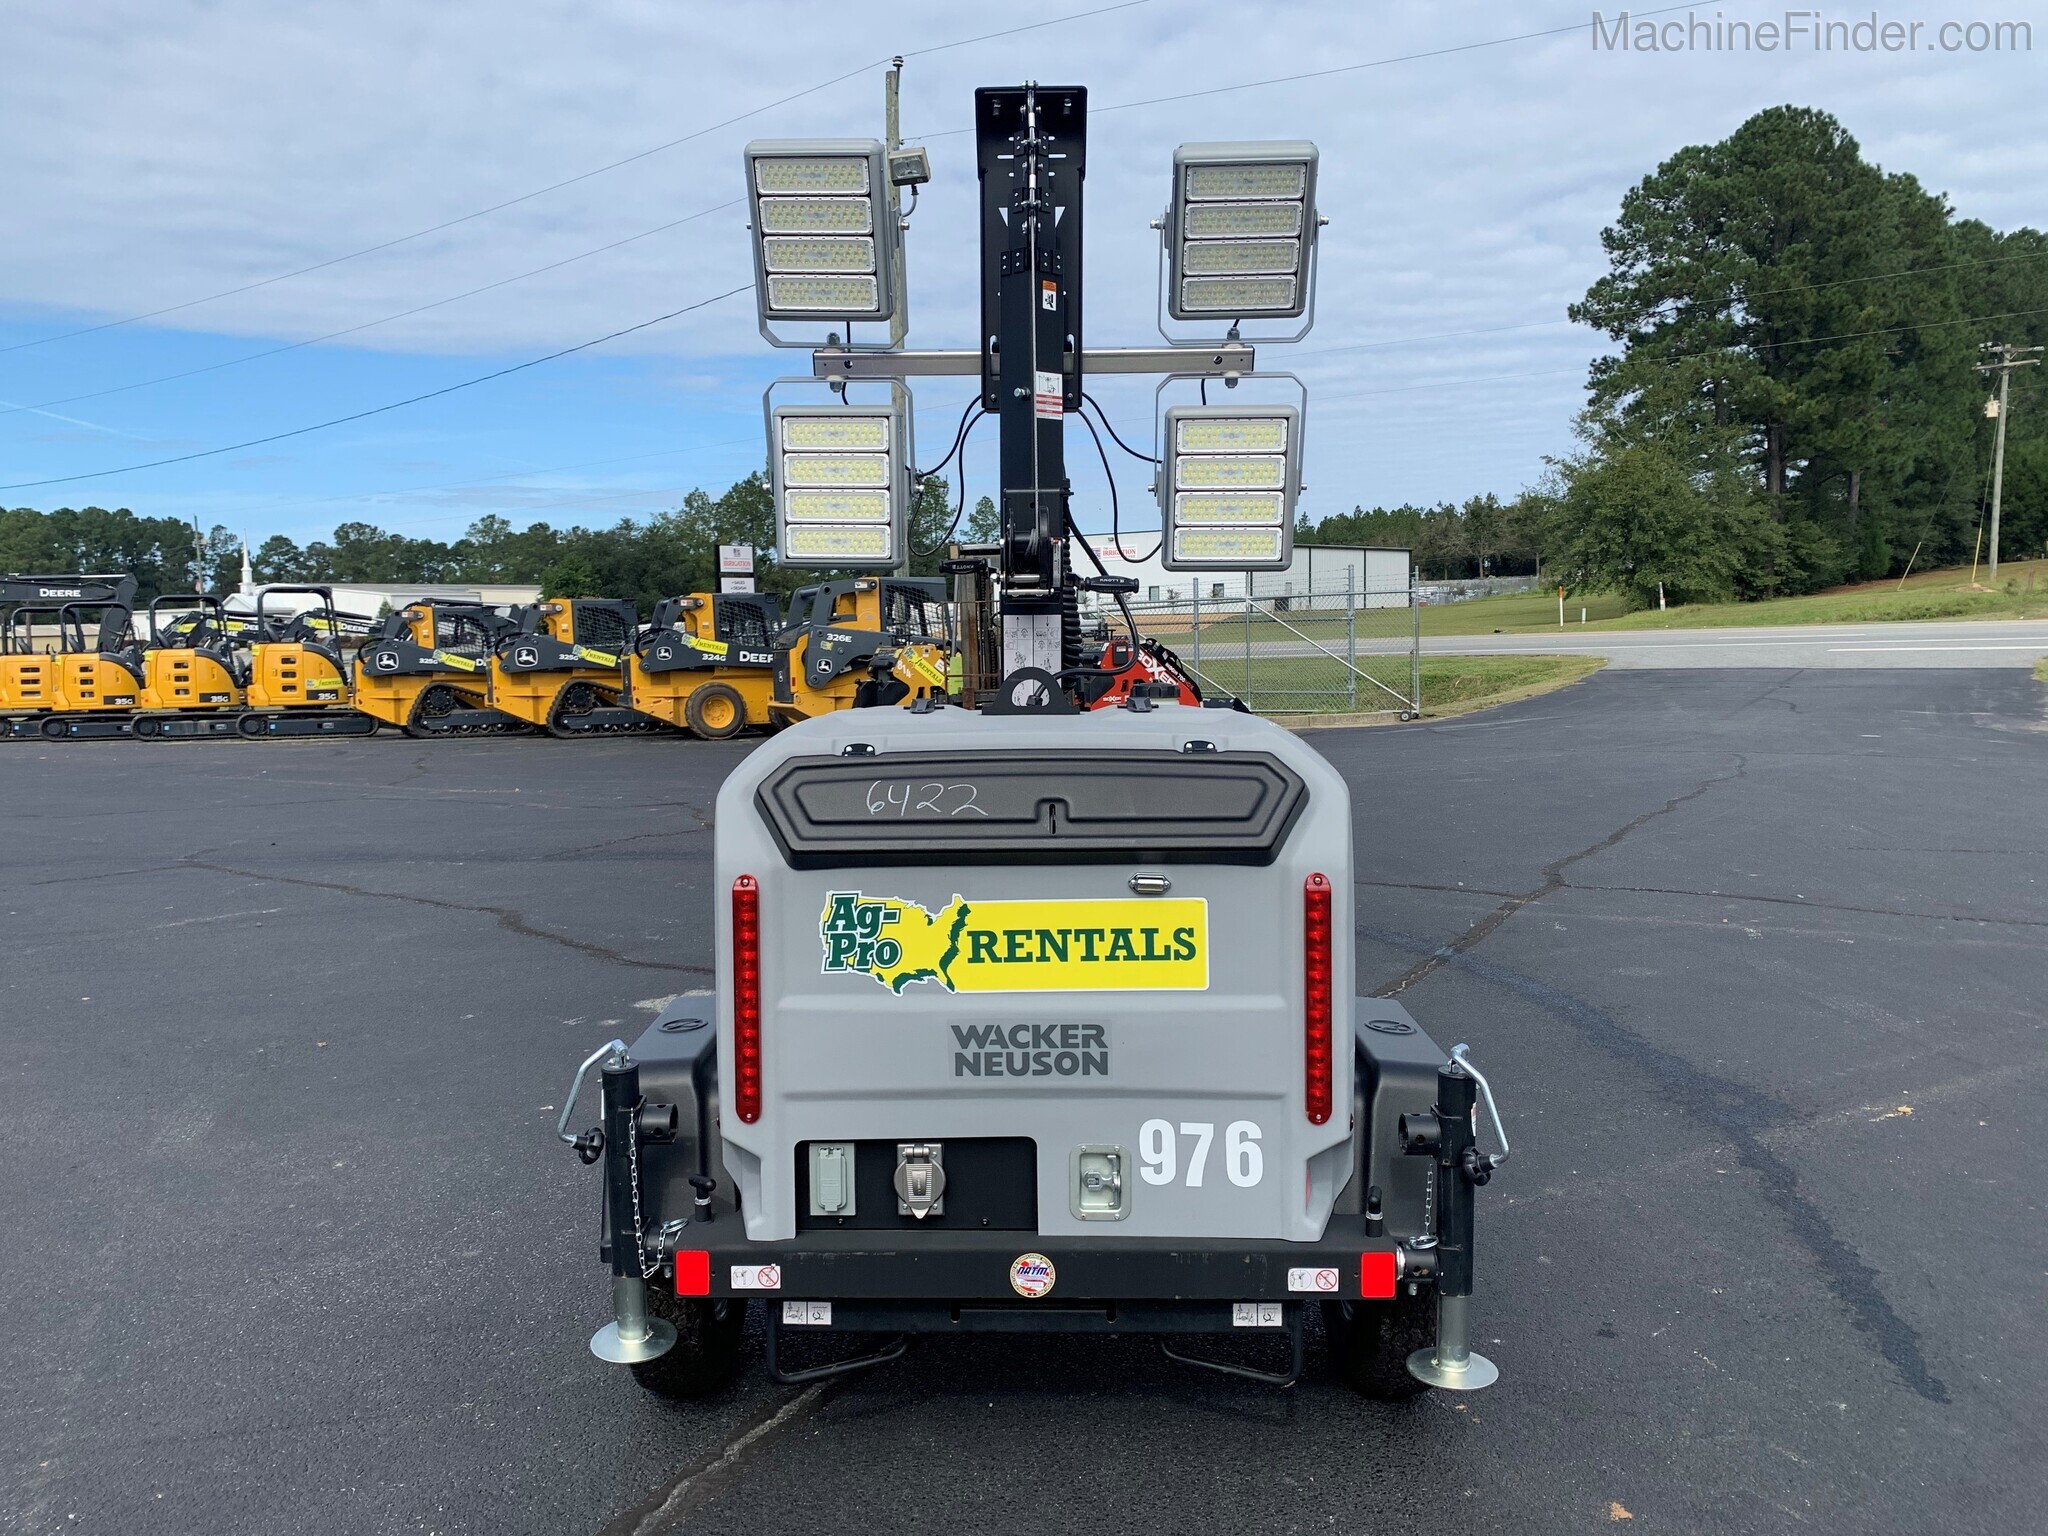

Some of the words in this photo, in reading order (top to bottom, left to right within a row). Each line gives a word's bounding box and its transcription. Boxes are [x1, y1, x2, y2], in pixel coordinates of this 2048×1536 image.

[39, 588, 81, 597] DEERE
[341, 623, 370, 633] DEERE
[826, 633, 853, 643] 326E
[701, 653, 727, 662] 324G
[739, 650, 774, 663] DEER
[210, 695, 229, 703] 35G
[317, 692, 337, 700] 35G
[866, 780, 989, 817] 6422
[824, 894, 901, 940] Ag-
[824, 932, 902, 971] Pro
[966, 927, 1197, 964] RENTALS
[950, 1024, 1109, 1050] WACKER
[954, 1051, 1109, 1077] NEUSON
[1138, 1118, 1264, 1188] 976
